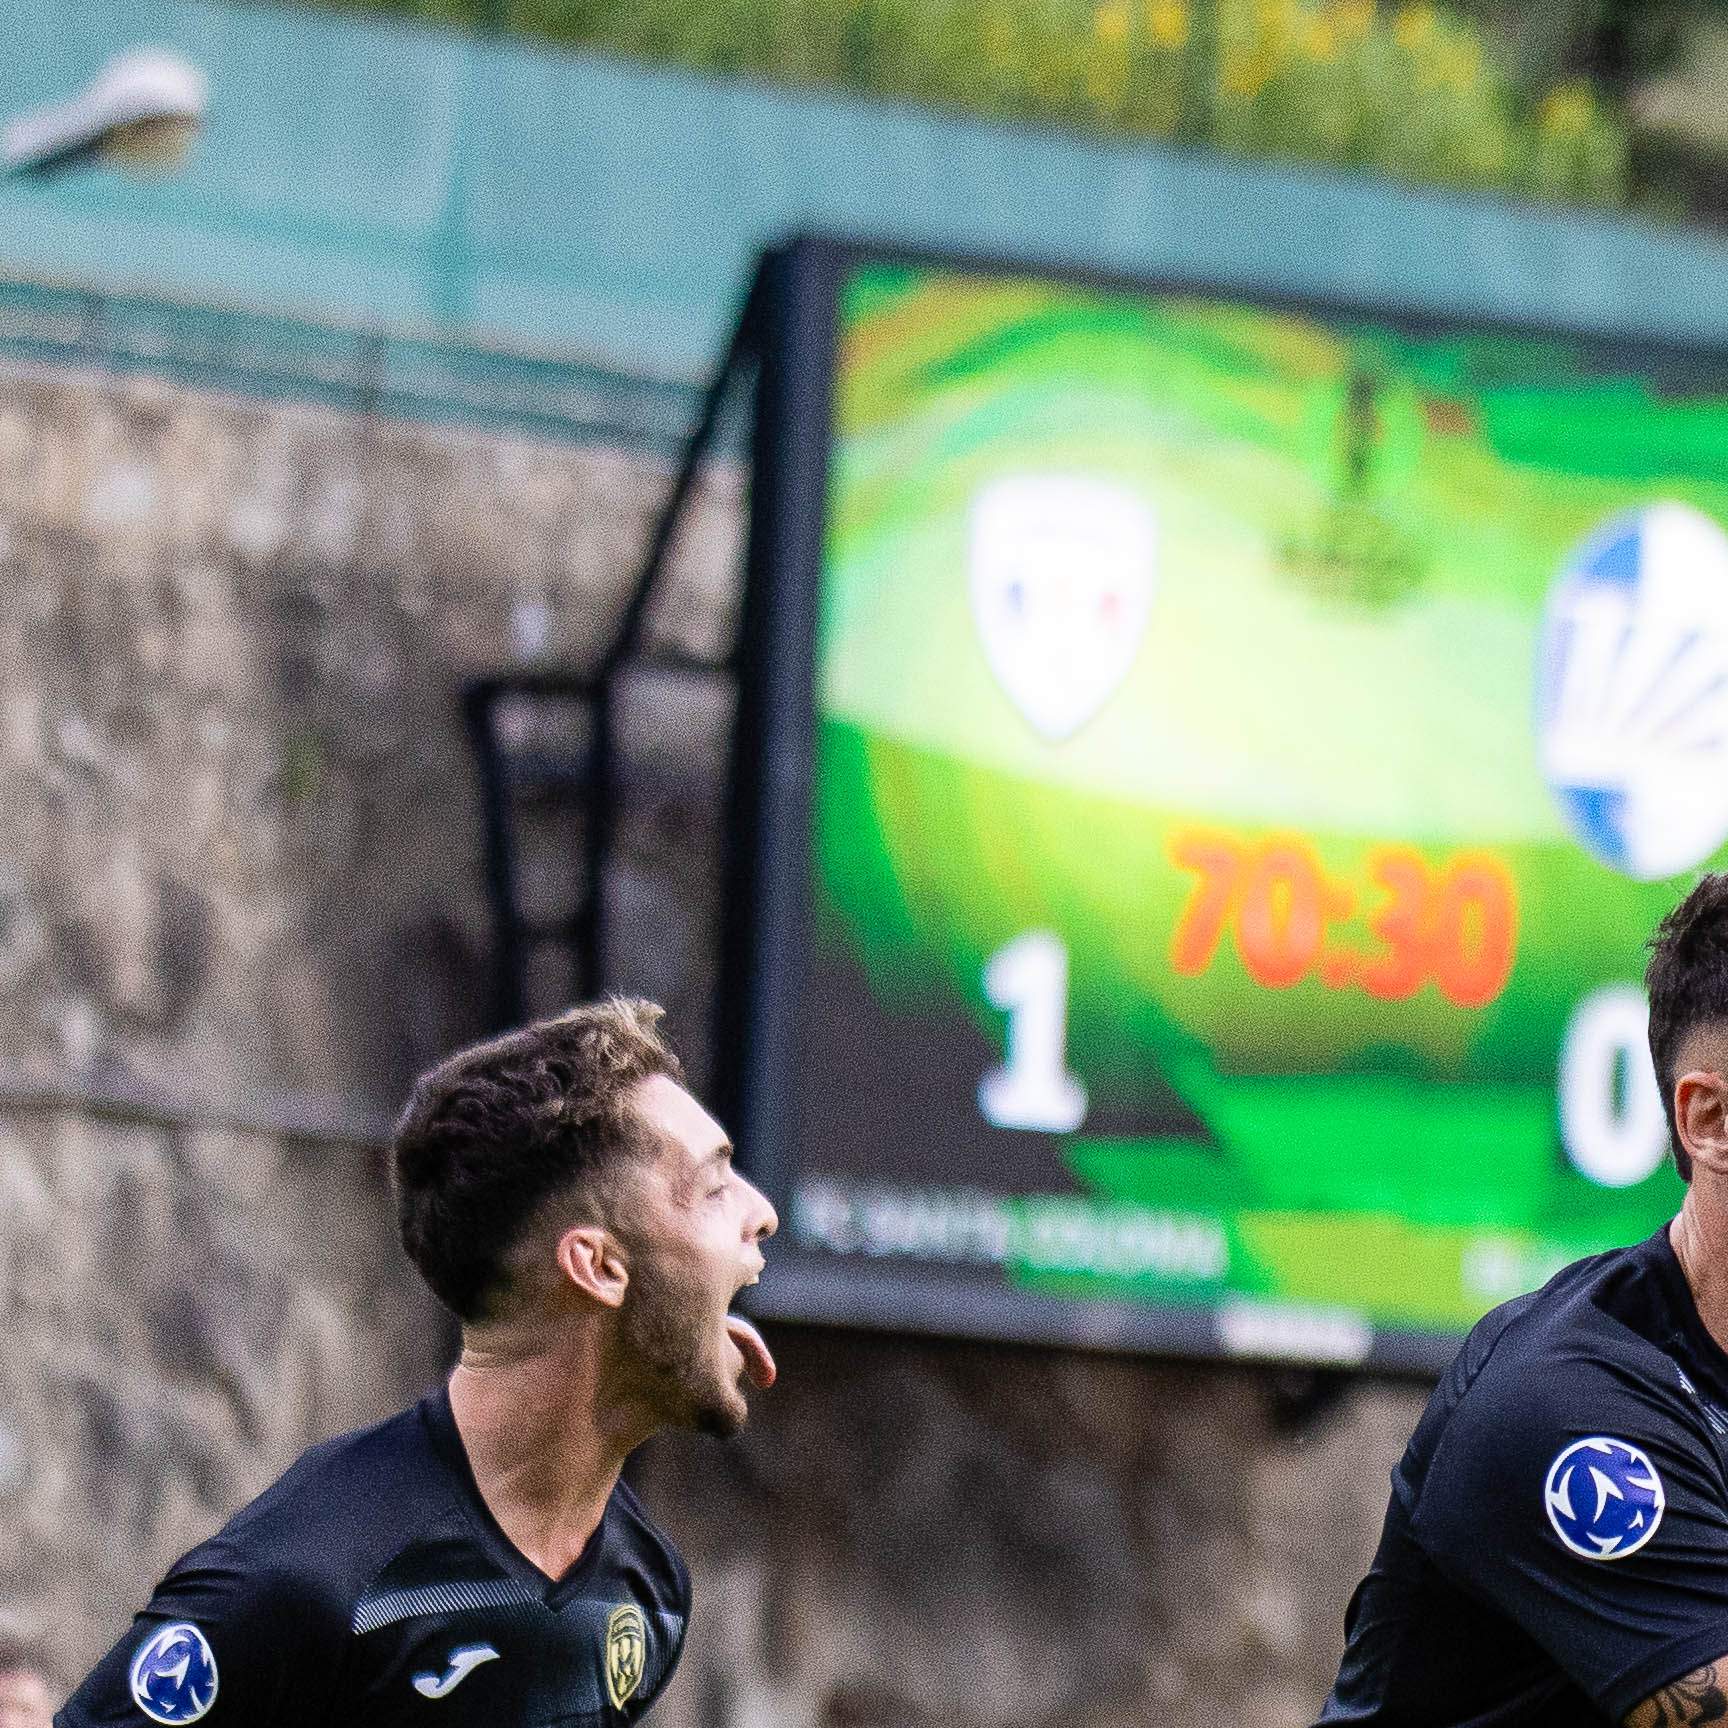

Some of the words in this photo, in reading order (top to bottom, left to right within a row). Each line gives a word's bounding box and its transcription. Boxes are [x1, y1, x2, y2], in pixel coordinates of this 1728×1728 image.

[1166, 828, 1518, 1008] 70:30
[979, 928, 1088, 1134] 1
[1559, 982, 1673, 1188] 0
